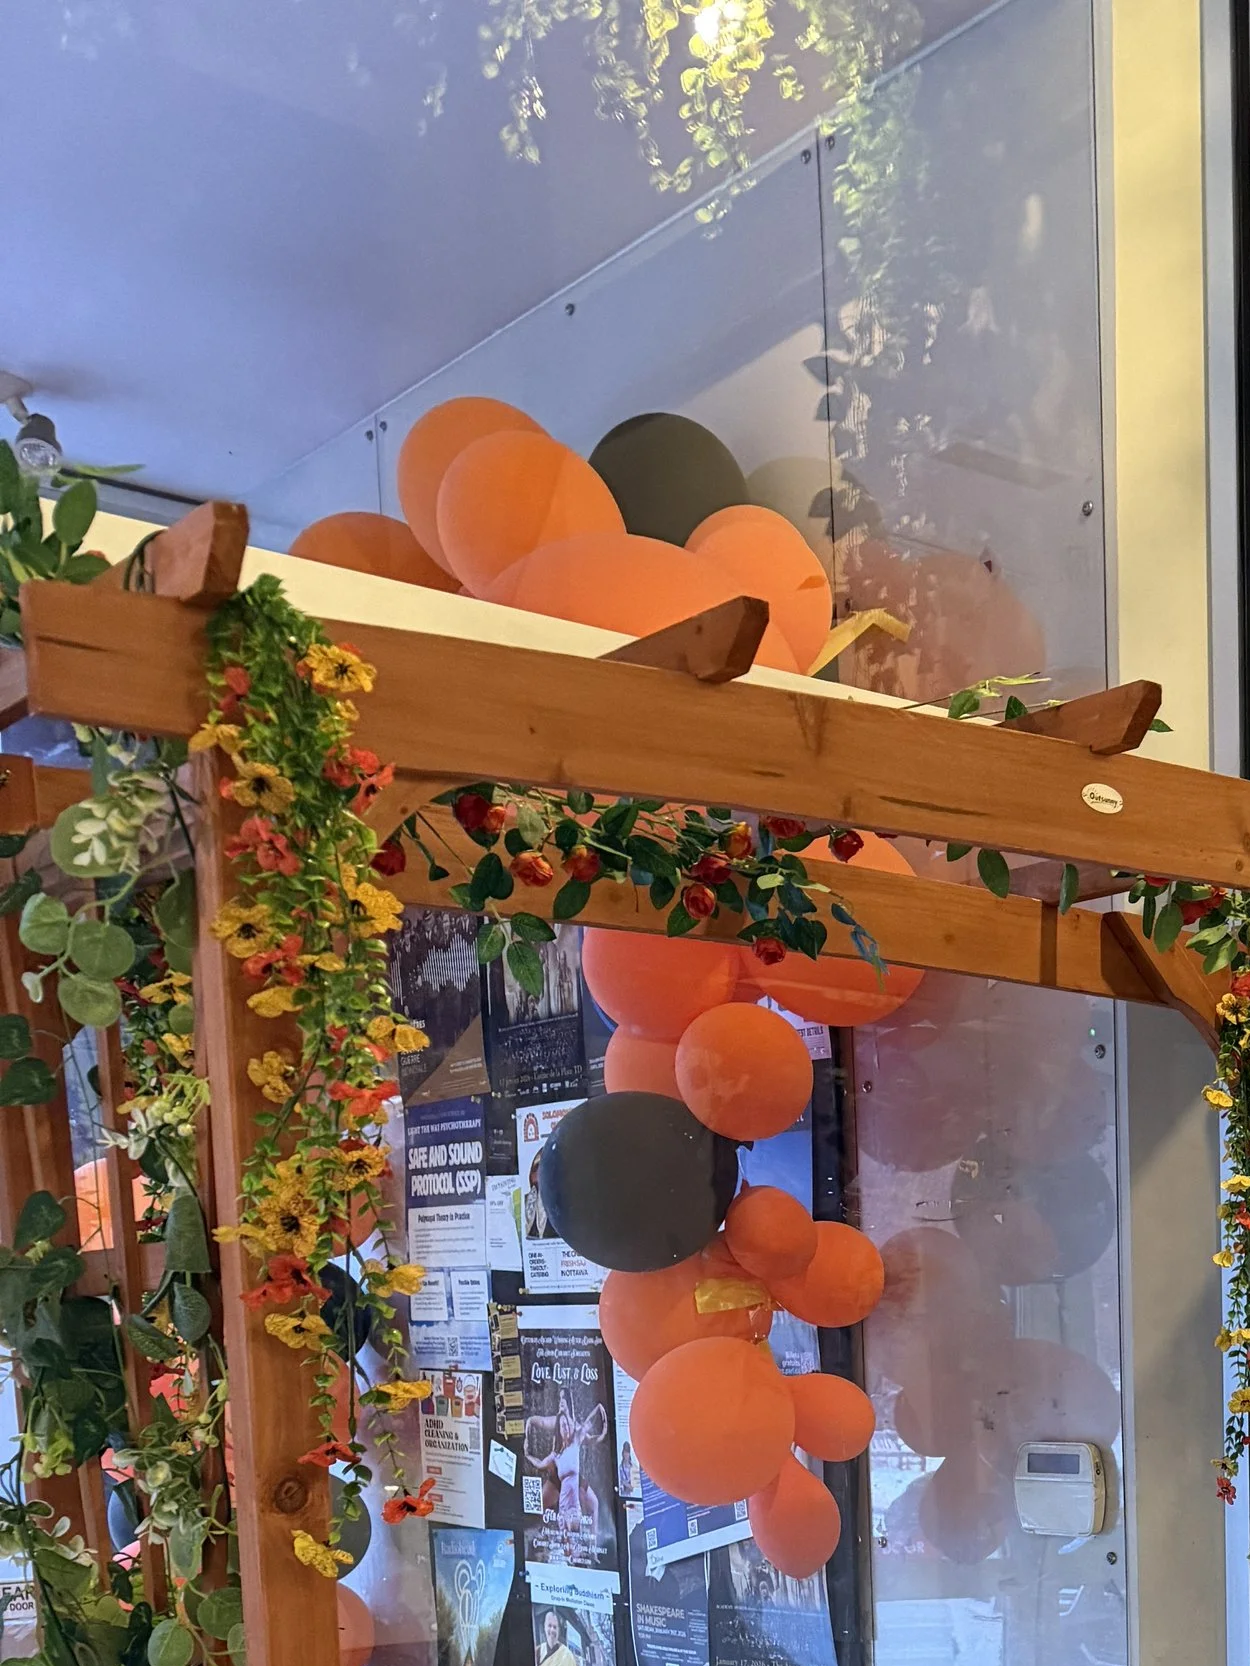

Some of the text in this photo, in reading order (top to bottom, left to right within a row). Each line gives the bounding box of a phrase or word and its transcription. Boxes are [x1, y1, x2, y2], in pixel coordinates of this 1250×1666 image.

[1089, 791, 1118, 808] Outsunny
[408, 1146, 428, 1170] SAFE
[428, 1144, 448, 1168] AND
[448, 1141, 483, 1166] SOUND
[411, 1171, 455, 1197] PROTOCOL
[455, 1168, 482, 1197] (SSP)
[580, 1362, 599, 1386] LOSS
[424, 1418, 443, 1429] ADHD
[424, 1428, 453, 1440] CLEANING
[424, 1439, 469, 1452] ORGANIZATION
[540, 1582, 574, 1596] Exploring
[575, 1587, 605, 1600] Buddhism
[10, 1601, 35, 1612] DOOR
[636, 1603, 685, 1619] SHAKESPEARE
[636, 1613, 667, 1628] IN MUSIC
